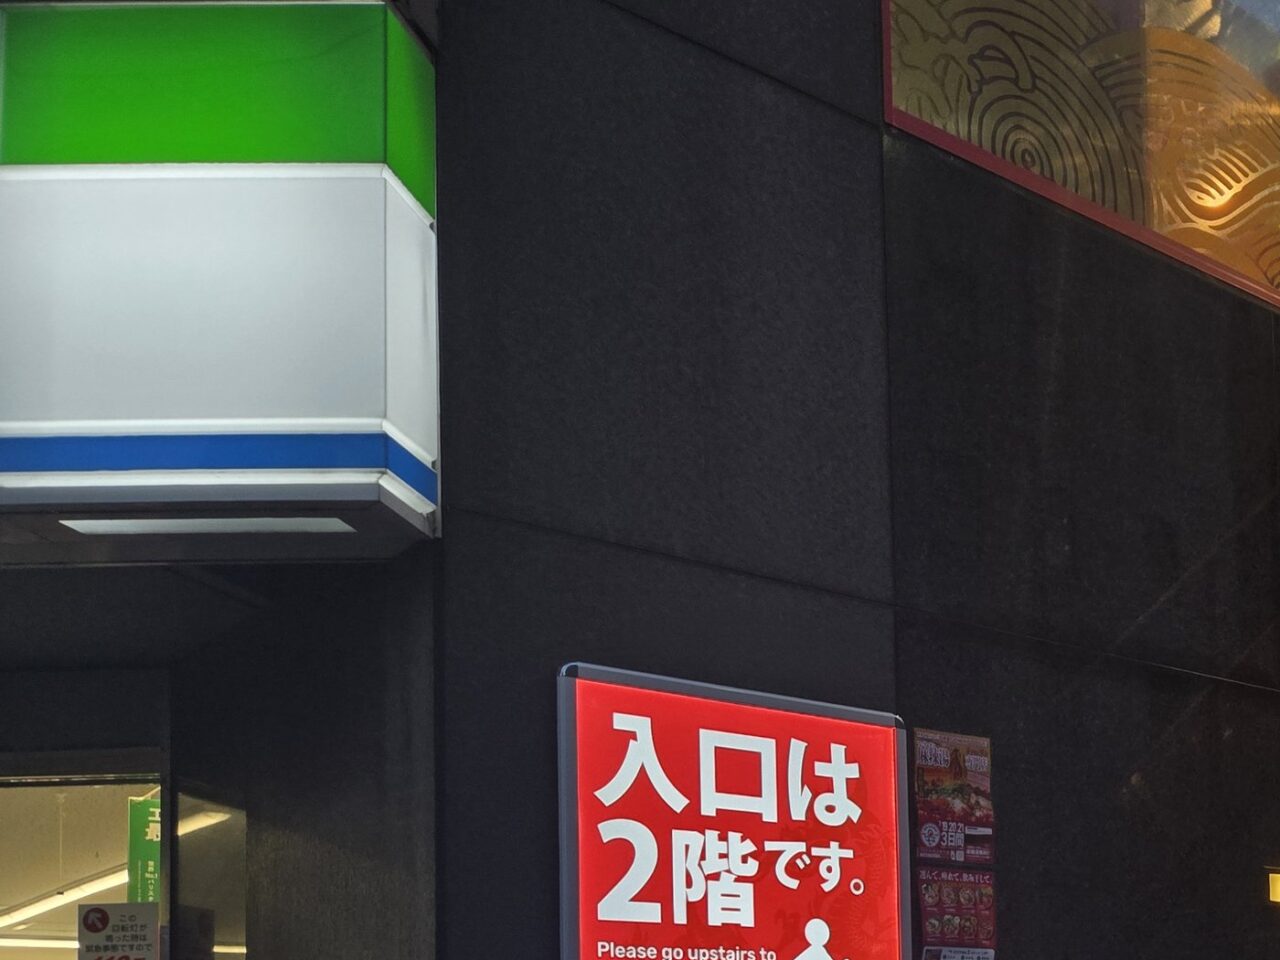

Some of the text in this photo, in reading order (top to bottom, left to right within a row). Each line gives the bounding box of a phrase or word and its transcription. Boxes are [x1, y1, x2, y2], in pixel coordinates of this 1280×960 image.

[593, 712, 862, 827] 入口は
[597, 941, 657, 959] Please
